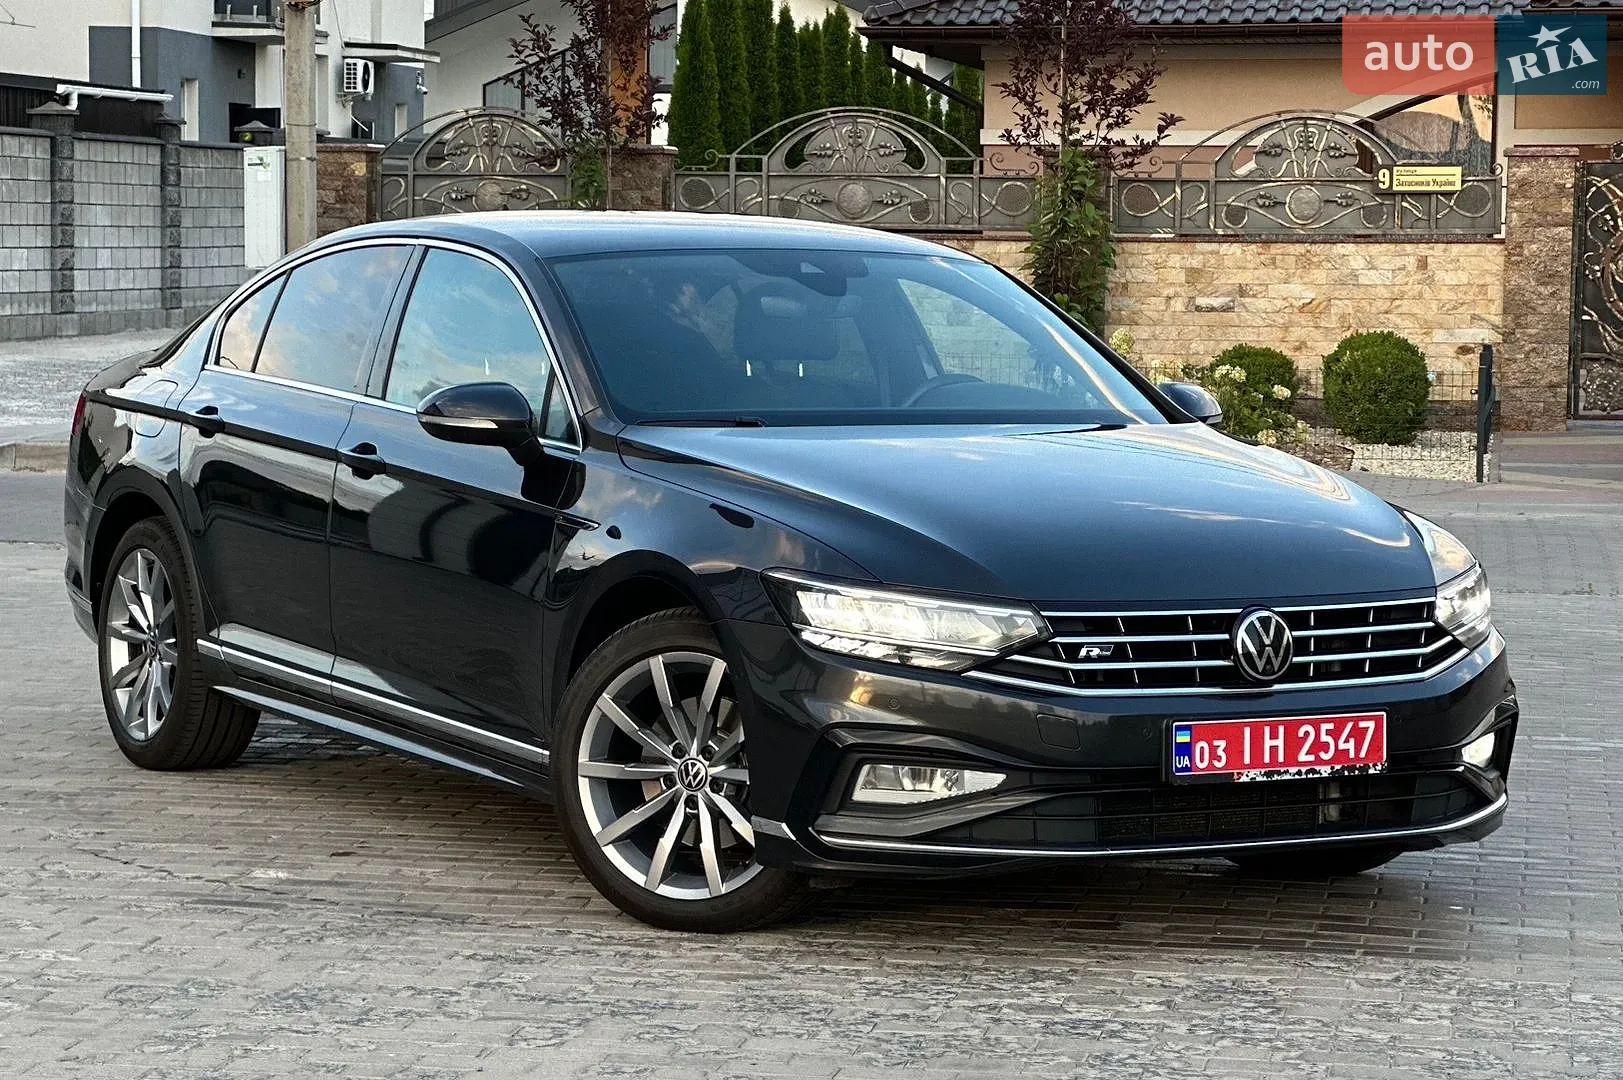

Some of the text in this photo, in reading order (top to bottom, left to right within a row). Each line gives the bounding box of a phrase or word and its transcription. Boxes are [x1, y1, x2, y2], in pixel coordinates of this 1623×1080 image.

[1378, 168, 1390, 190] 9
[1431, 178, 1456, 188] України
[1194, 720, 1376, 769] 03 IH 2547
[1175, 755, 1191, 768] UA
